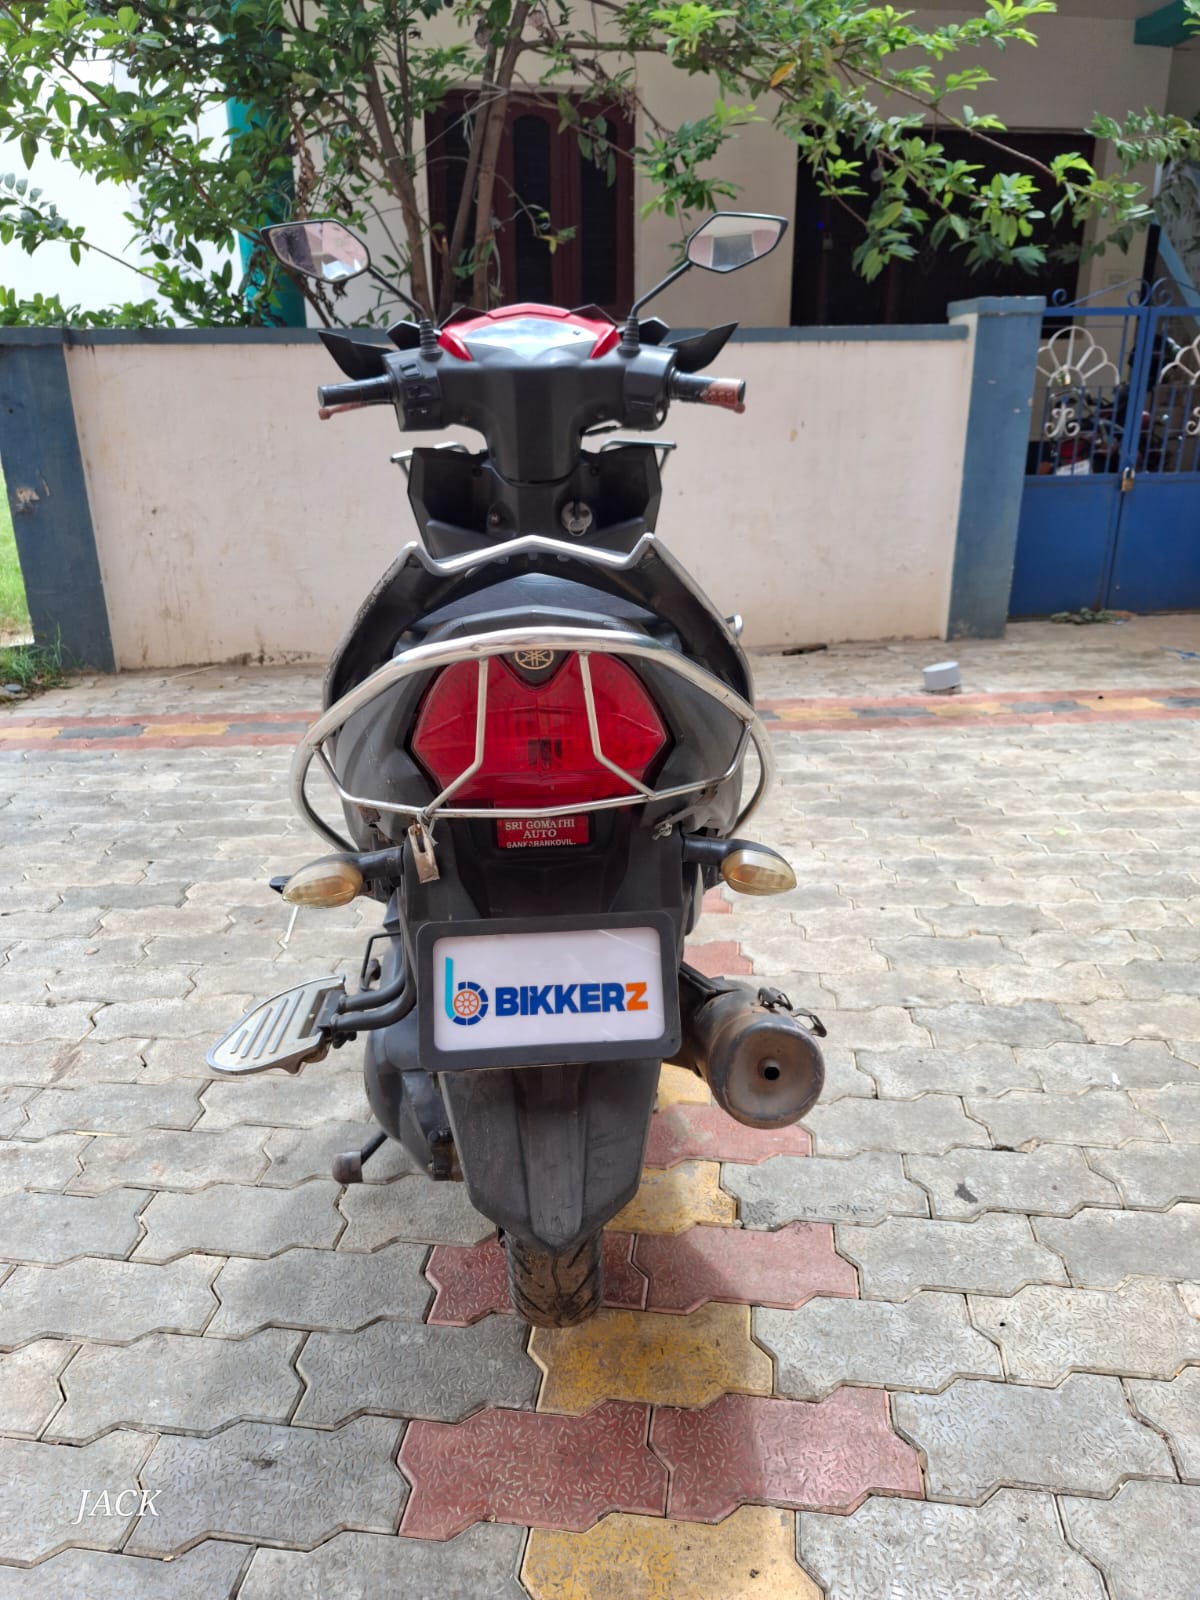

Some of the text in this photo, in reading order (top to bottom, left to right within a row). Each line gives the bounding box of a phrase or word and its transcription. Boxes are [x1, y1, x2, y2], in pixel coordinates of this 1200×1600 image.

[505, 819, 576, 831] SRI GOMATHI
[522, 829, 557, 839] AUTO
[495, 982, 648, 1016] BIKKERZ
